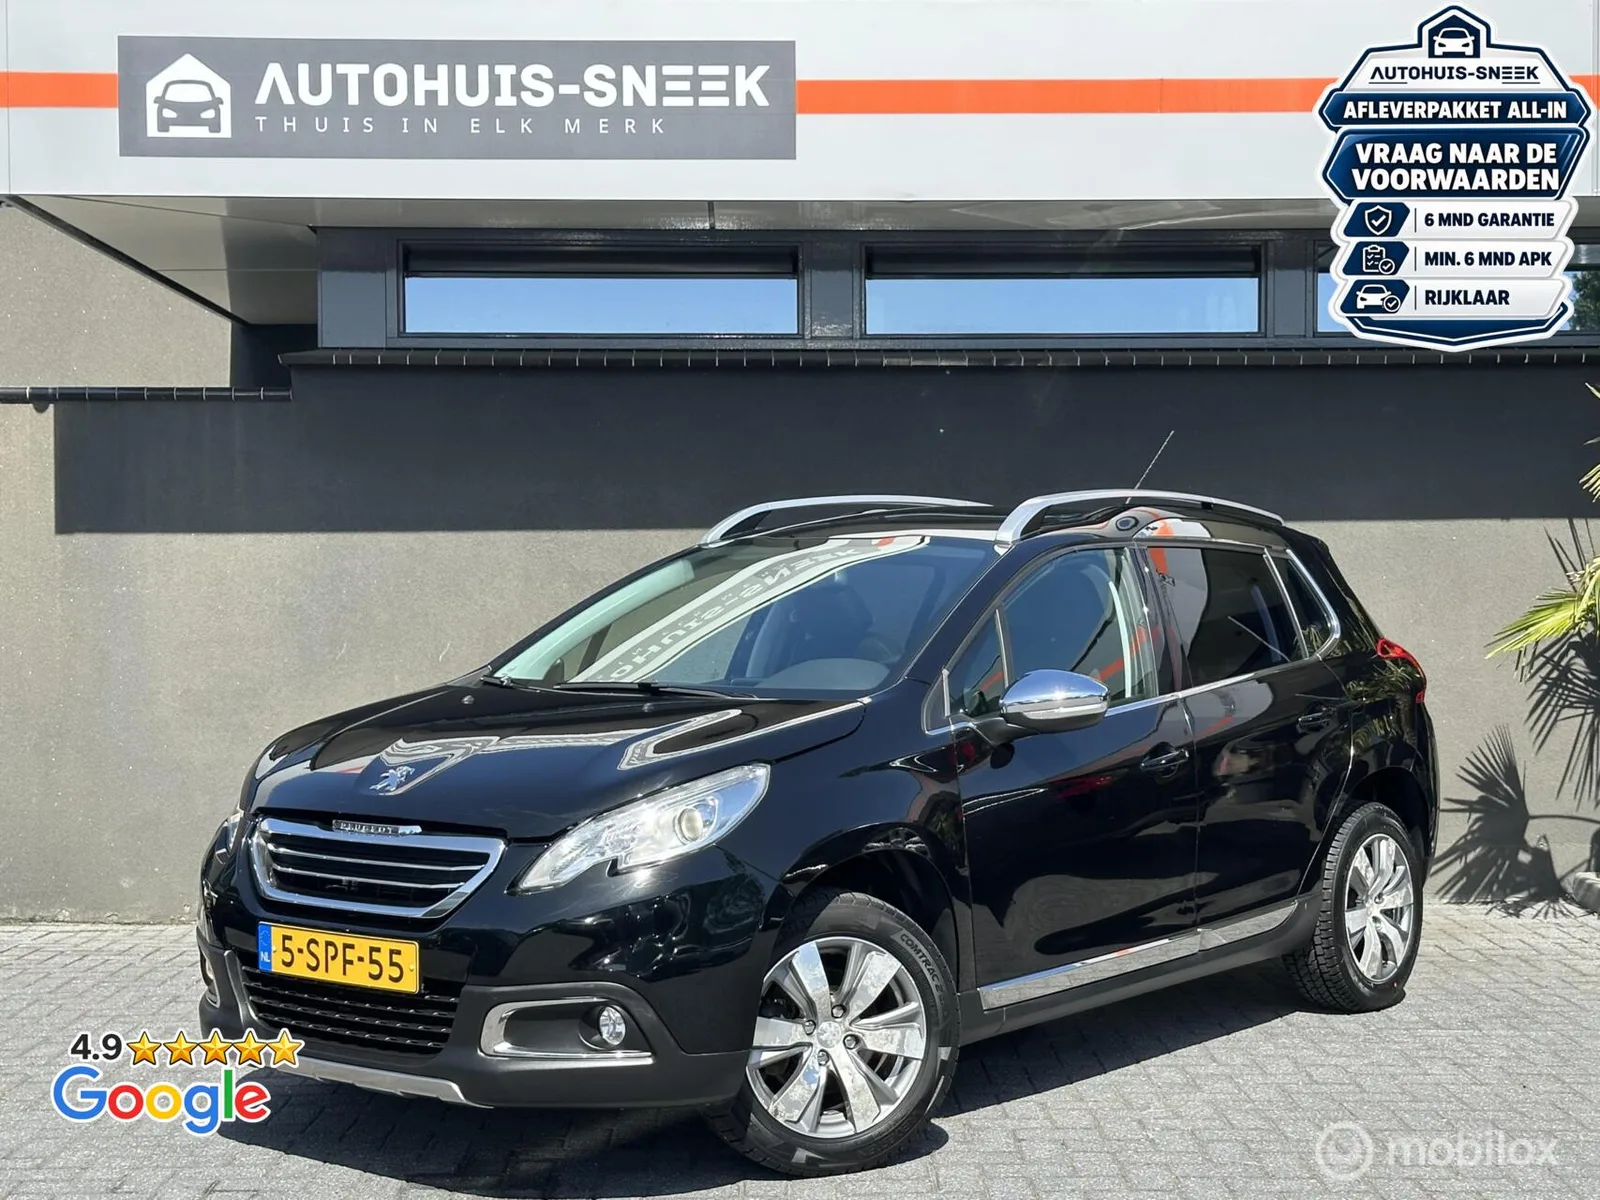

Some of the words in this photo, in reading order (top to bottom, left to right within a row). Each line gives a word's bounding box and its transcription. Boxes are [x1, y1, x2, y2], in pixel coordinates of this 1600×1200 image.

[254, 62, 770, 108] AUTOHUIS-SNEEK
[254, 116, 374, 133] THUIS
[402, 117, 437, 134] IN
[470, 117, 533, 134] ELK
[564, 118, 664, 134] MERK
[260, 951, 271, 963] NL
[281, 934, 404, 983] 5-SPF-55
[900, 933, 940, 982] COMTRAC
